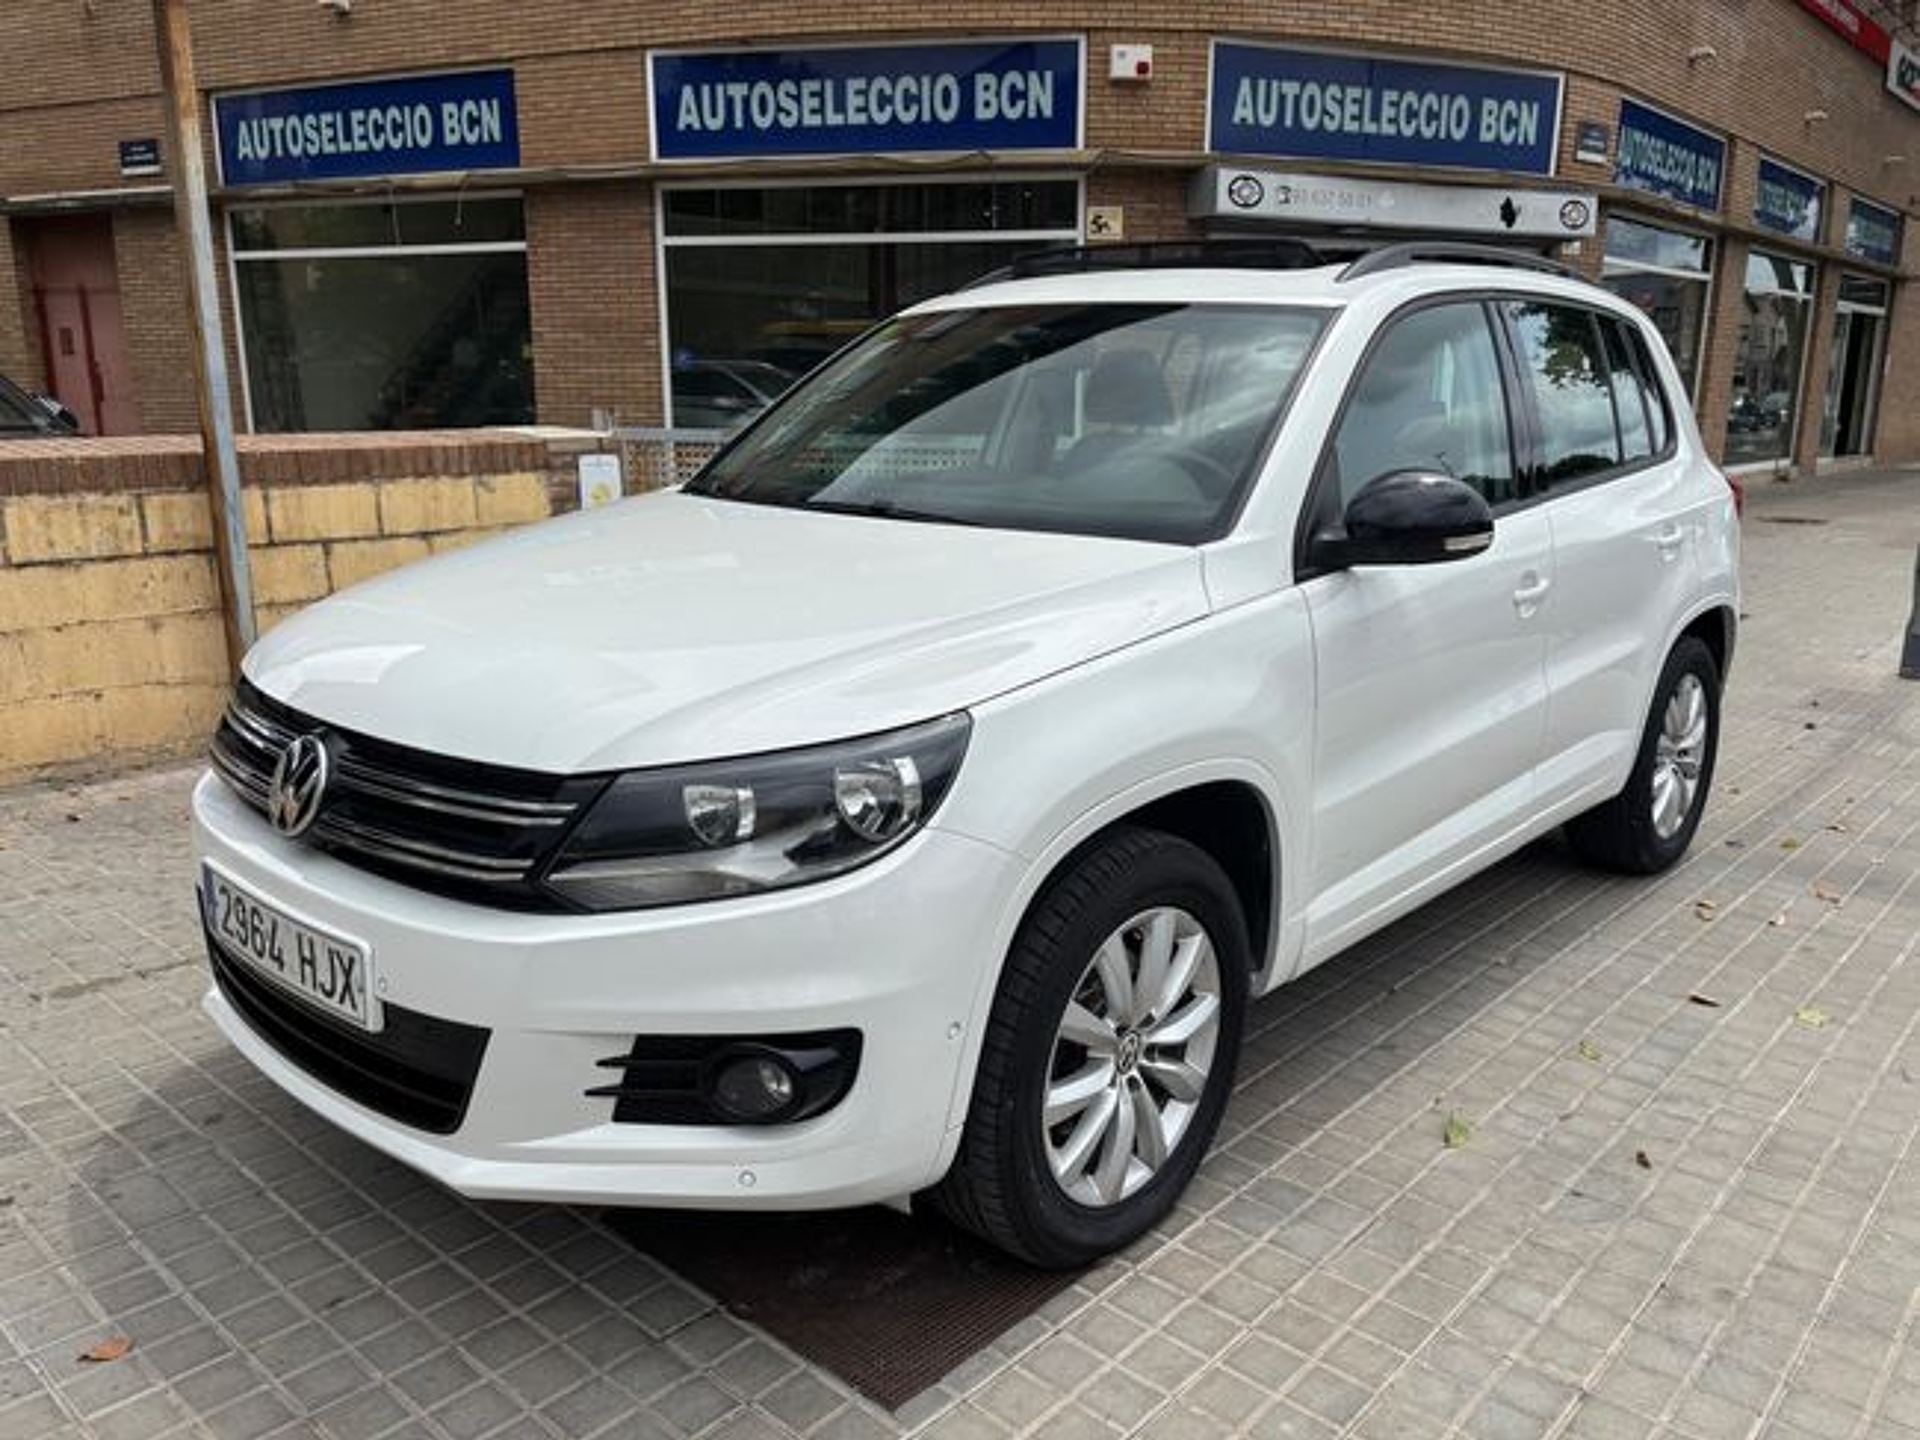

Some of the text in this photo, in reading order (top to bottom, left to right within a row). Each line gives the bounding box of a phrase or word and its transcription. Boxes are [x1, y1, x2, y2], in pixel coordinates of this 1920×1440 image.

[238, 98, 501, 161] AUTOSELECCIO BCN
[676, 70, 1054, 132] AUTOSELECCIO BCN
[1232, 77, 1539, 145] AUTOSELECCIO BCN
[218, 885, 358, 1012] 2964 HJX
